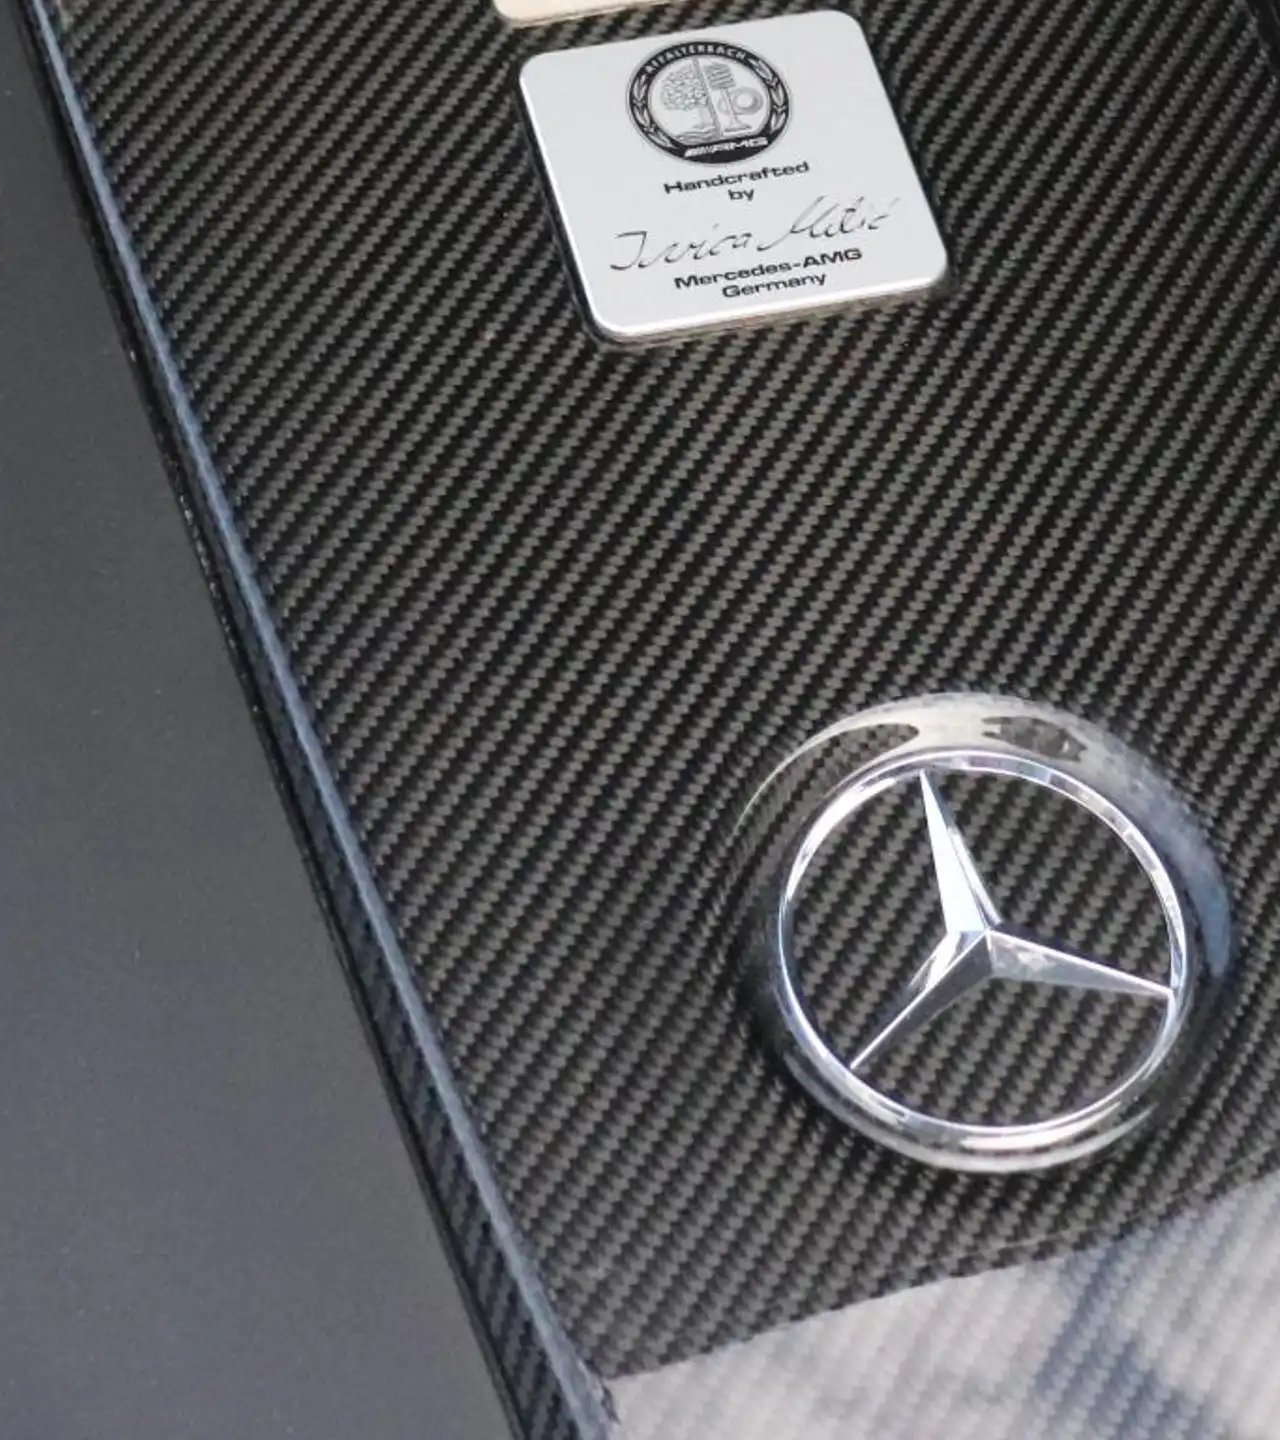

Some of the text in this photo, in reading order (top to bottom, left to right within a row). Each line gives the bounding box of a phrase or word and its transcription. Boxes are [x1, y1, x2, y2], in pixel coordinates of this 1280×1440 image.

[710, 135, 768, 153] AMG
[663, 161, 810, 194] Handcrafted
[728, 189, 754, 202] by
[674, 247, 863, 290] Mercedes-AMG
[722, 273, 827, 299] Germany
